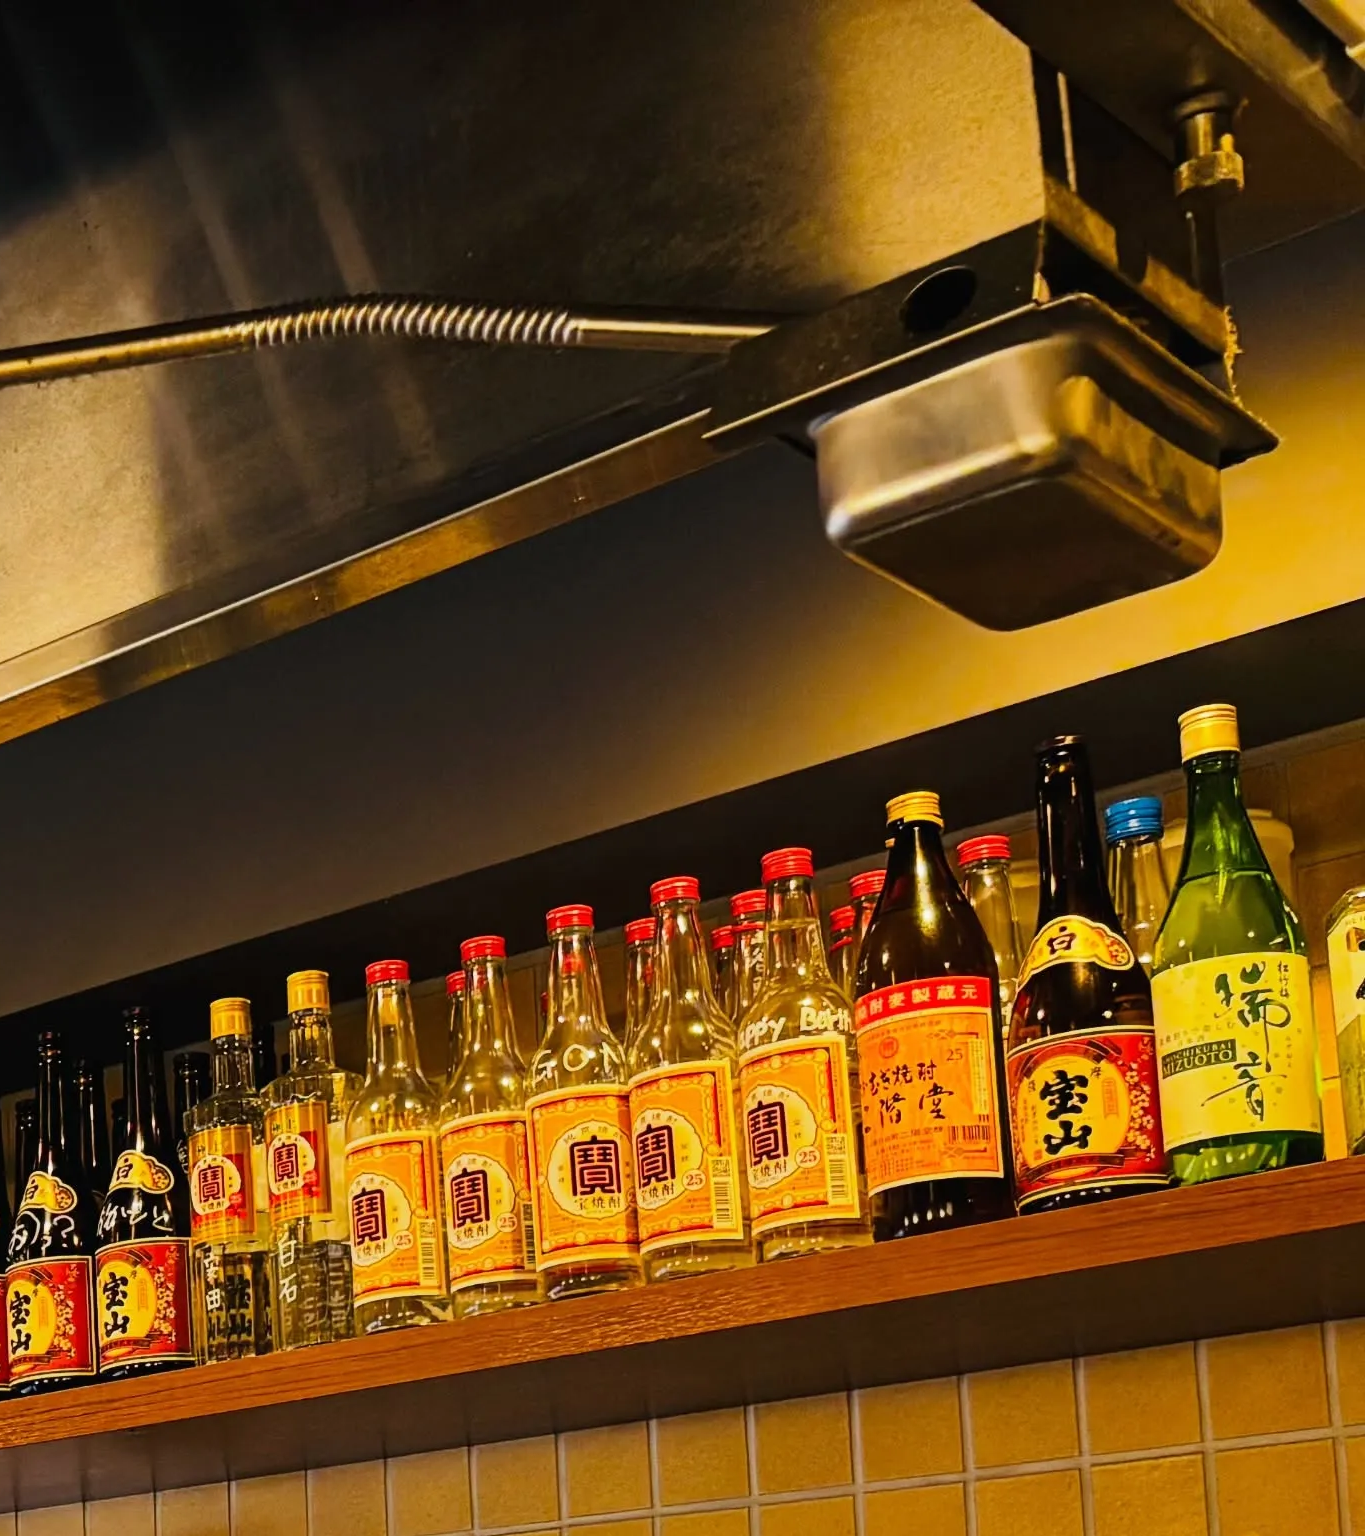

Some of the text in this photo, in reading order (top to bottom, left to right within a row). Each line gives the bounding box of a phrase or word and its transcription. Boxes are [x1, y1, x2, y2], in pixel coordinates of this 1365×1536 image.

[1039, 1069, 1093, 1156] 宝山
[798, 1149, 818, 1164] 25
[685, 1174, 704, 1186] 25
[498, 1216, 517, 1229] 25
[395, 1234, 413, 1247] 25
[102, 1271, 130, 1338] 宝山
[9, 1291, 33, 1355] 宝山
